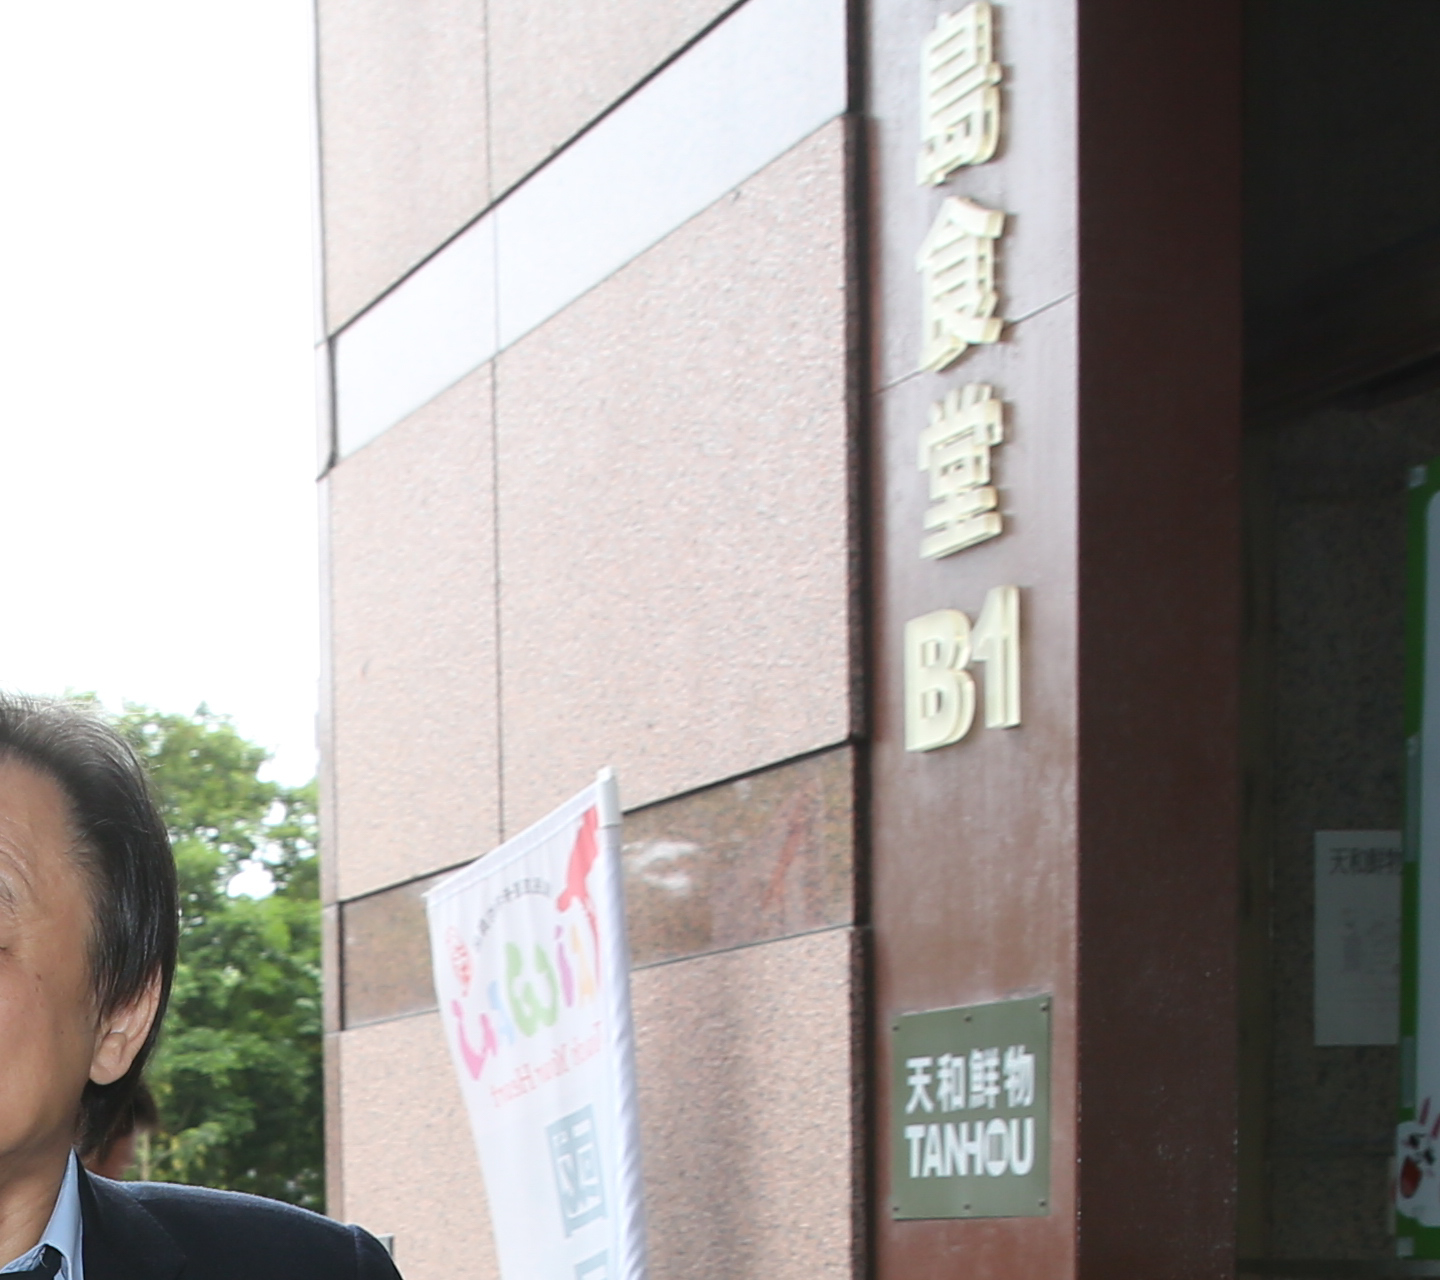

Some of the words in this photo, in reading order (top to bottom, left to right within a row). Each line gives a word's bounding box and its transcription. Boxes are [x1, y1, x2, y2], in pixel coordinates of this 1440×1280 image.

[905, 584, 1022, 752] B1
[904, 1044, 1036, 1115] 天和鮮物
[904, 1116, 1036, 1179] TANHOU
